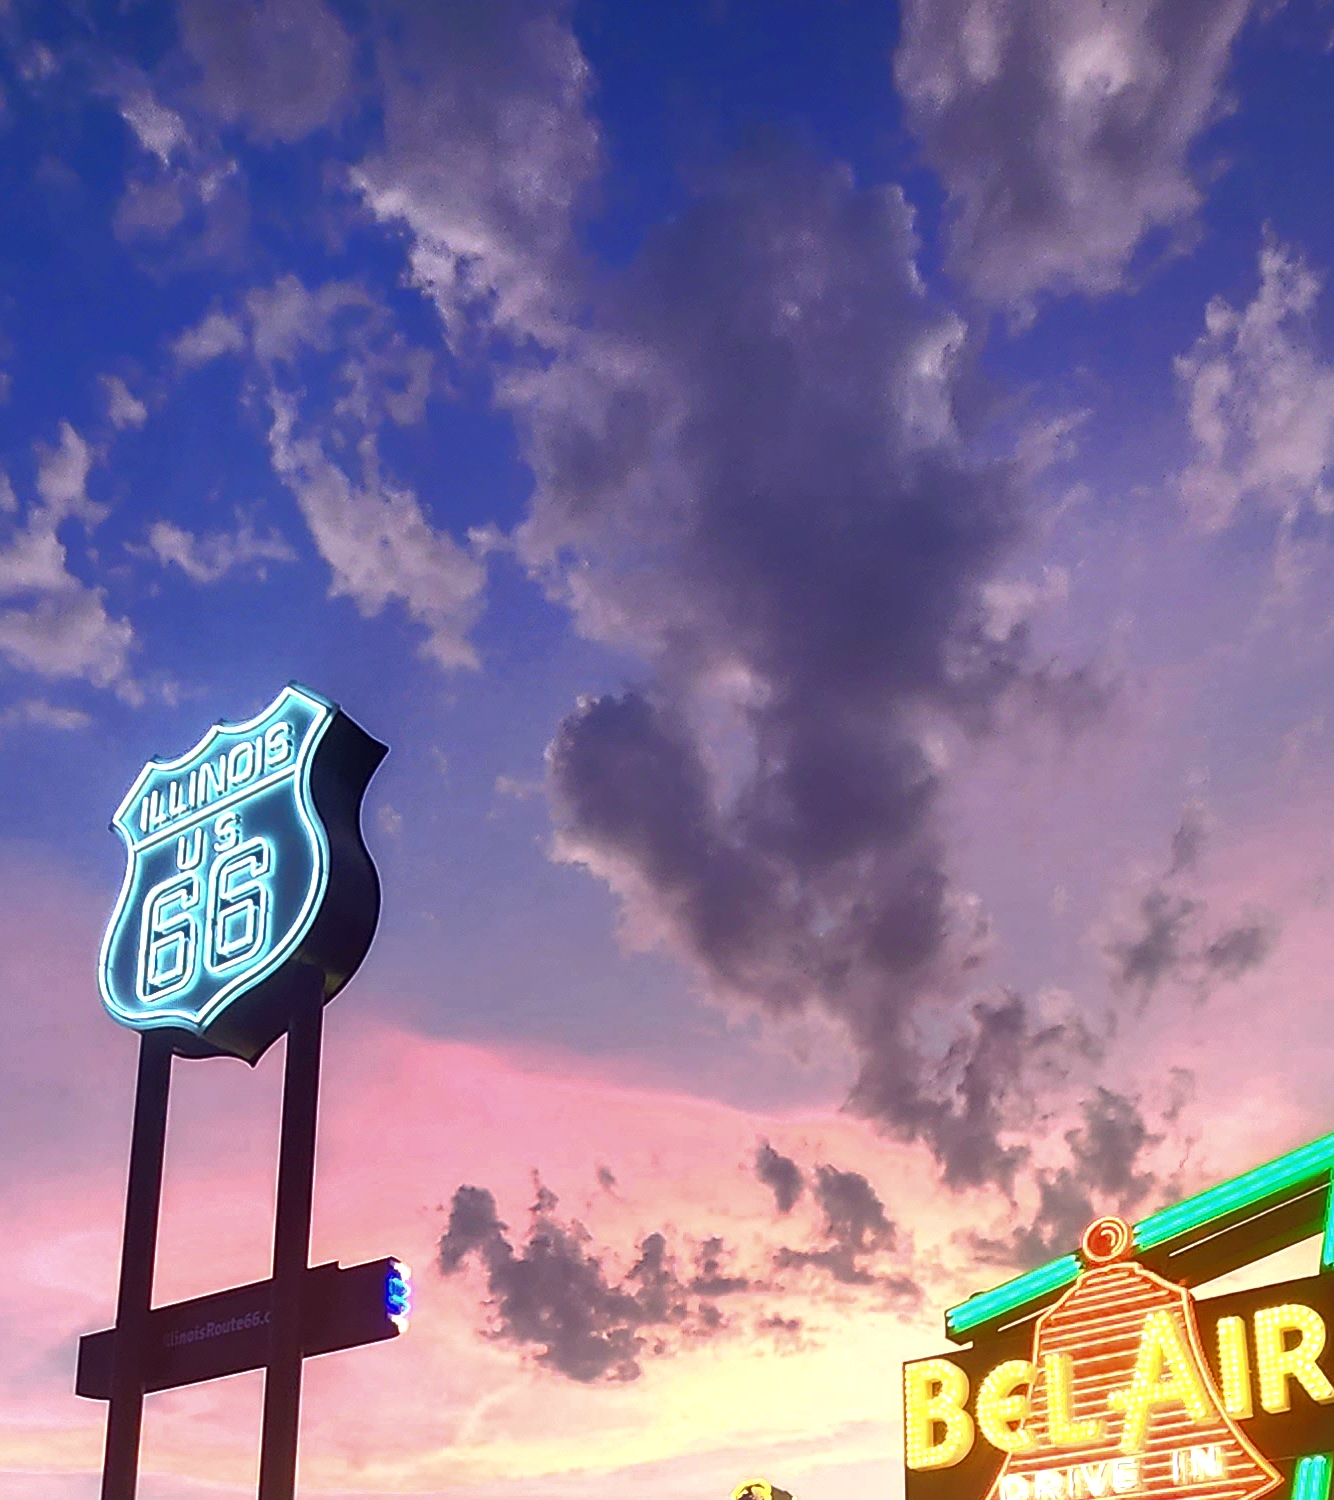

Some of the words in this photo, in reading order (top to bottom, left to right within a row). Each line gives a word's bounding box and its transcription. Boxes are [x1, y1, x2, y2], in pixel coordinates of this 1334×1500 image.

[140, 721, 293, 833] ILLINOIS
[136, 836, 271, 1003] 66
[1171, 1445, 1226, 1485] IN
